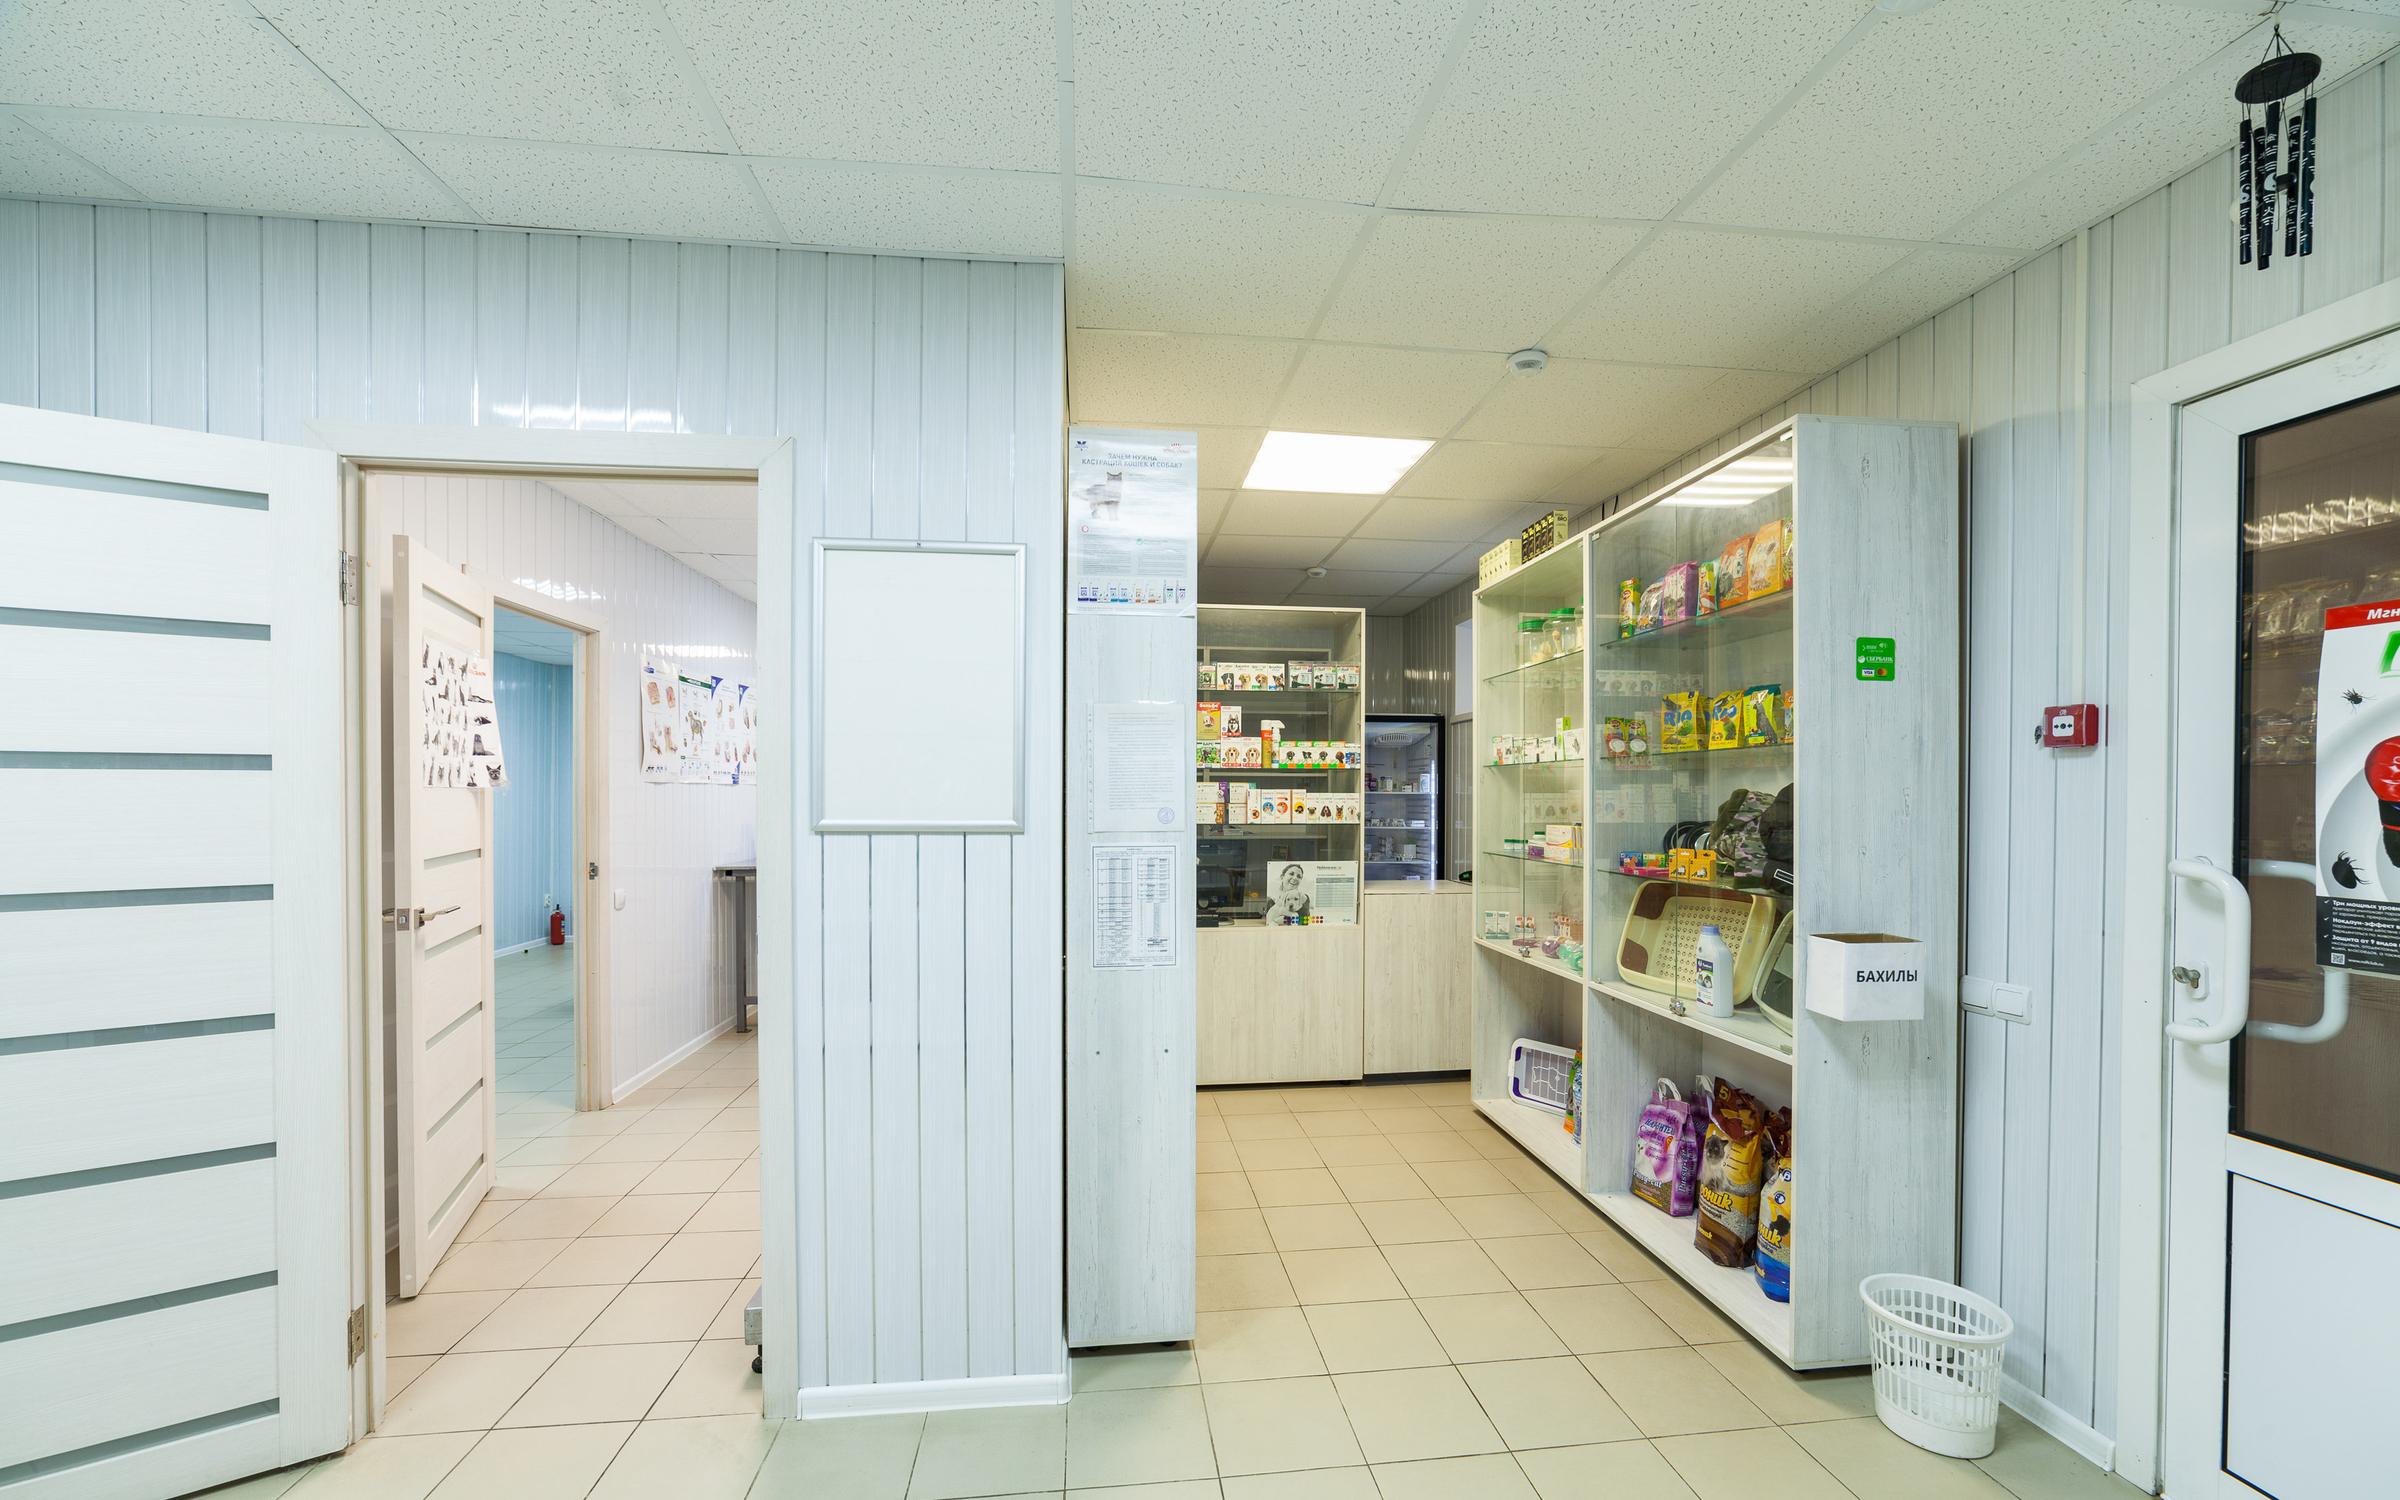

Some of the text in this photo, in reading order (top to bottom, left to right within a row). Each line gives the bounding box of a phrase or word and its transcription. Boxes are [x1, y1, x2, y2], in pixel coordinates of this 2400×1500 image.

[1664, 709, 1692, 726] RIO
[2346, 902, 2377, 910] мощных
[2332, 917, 2395, 929] Нокдаун-эффект
[2331, 934, 2360, 943] Защита
[1856, 969, 1918, 983] БАХИЛЫ
